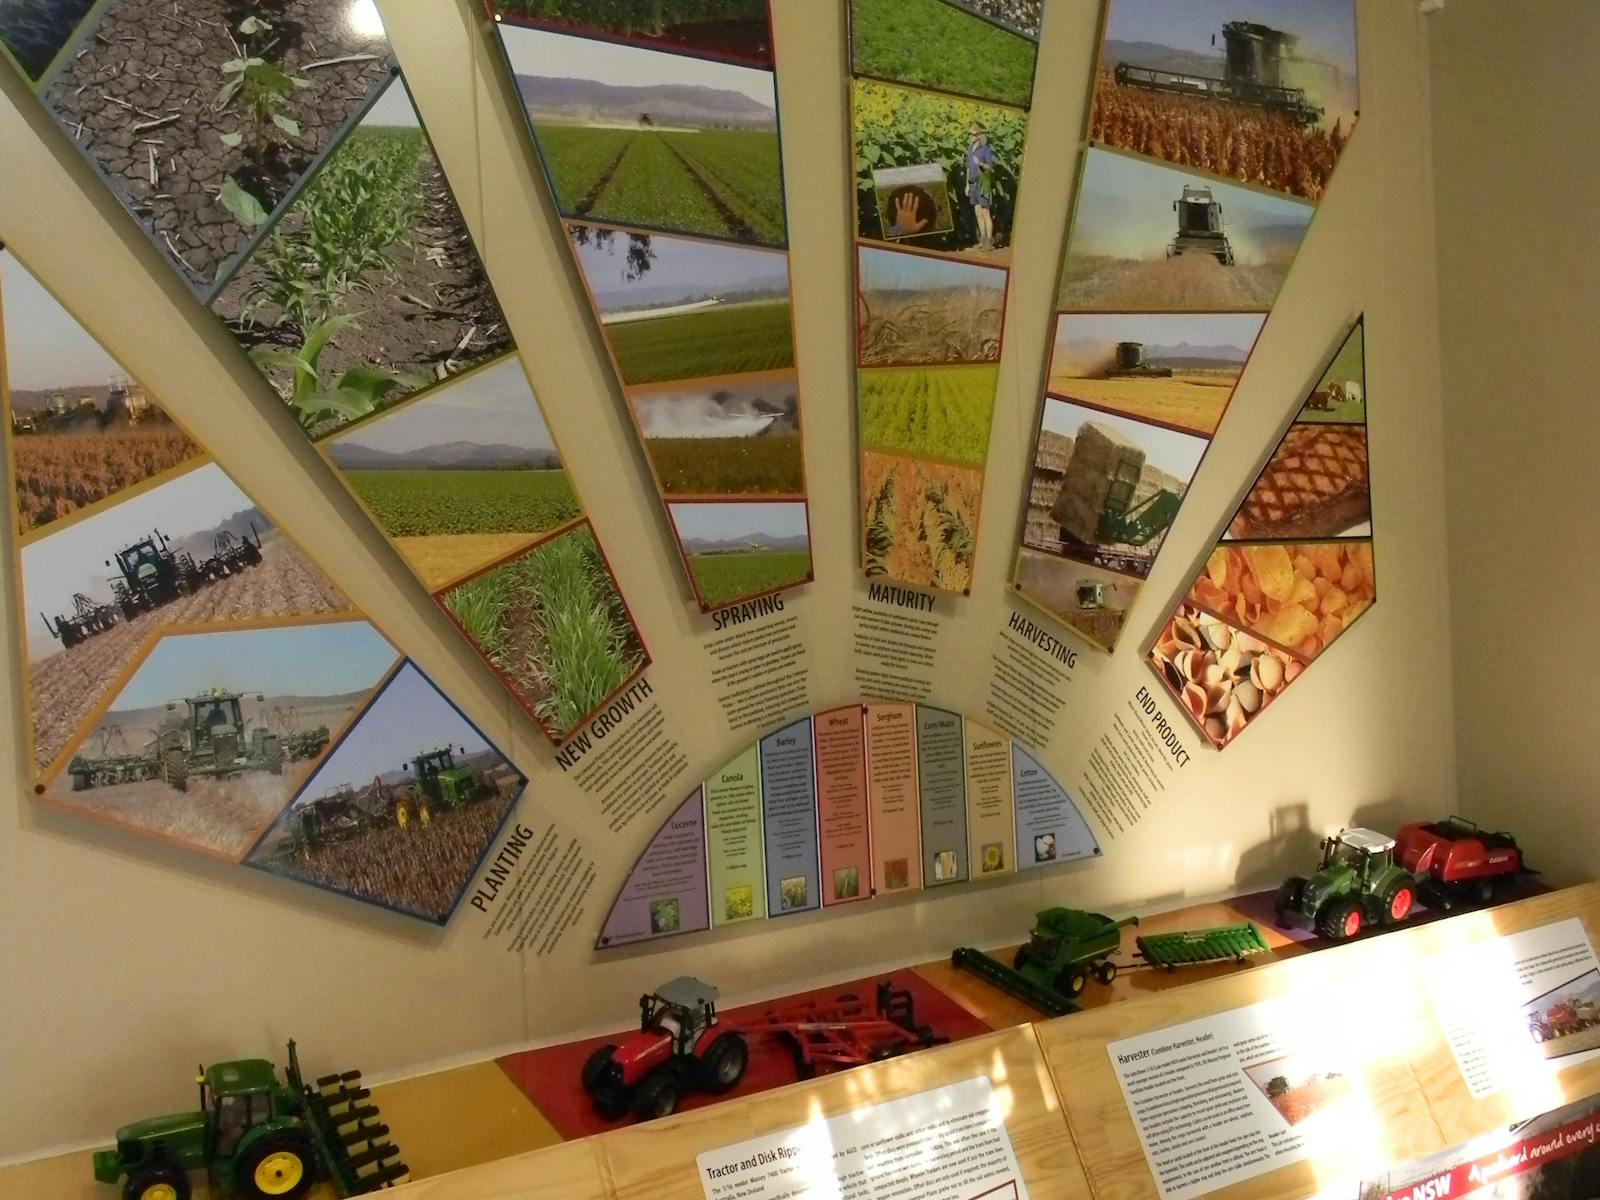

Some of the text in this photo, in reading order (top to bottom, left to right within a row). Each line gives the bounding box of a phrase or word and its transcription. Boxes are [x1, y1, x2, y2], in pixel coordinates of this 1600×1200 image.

[712, 593, 785, 631] SPRAYING
[868, 582, 936, 612] MATURITY
[1008, 611, 1079, 669] HARVESTING
[555, 677, 653, 772] NEW GROWTH
[829, 717, 848, 726] Wheat
[877, 712, 903, 722] Sorghum
[1135, 686, 1191, 768] END PRODUCT
[776, 736, 796, 747] Barley
[722, 773, 744, 783] Canola
[1021, 769, 1038, 777] Cotton
[470, 824, 534, 912] PLANTING
[1118, 1049, 1150, 1064] Harvester
[706, 1146, 800, 1180] Tractor and Disk Ripp
[1412, 1173, 1451, 1200] NSW
[1530, 1133, 1563, 1158] around
[1566, 1124, 1594, 1143] every
